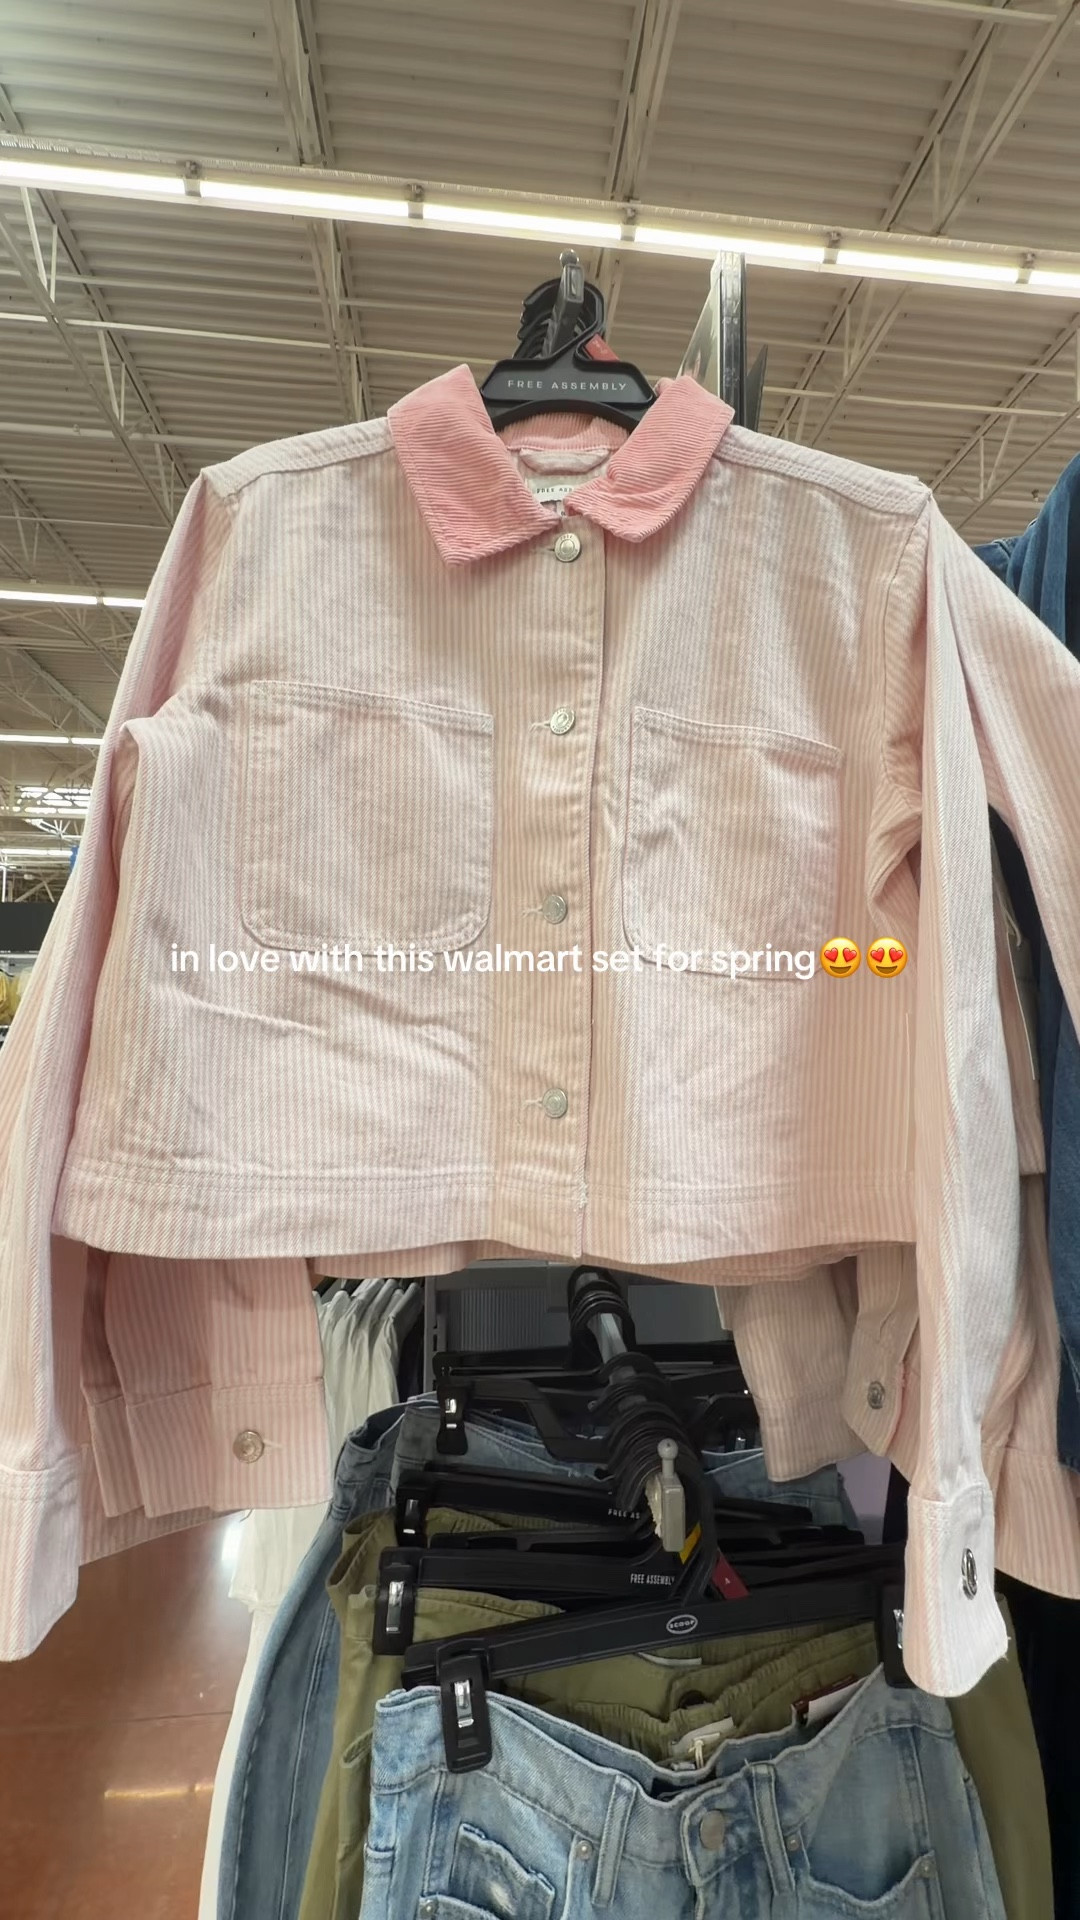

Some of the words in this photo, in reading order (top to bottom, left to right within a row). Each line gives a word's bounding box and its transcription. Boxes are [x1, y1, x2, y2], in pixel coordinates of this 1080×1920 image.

[507, 379, 543, 389] FREE
[551, 381, 627, 391] ASSEMBLY
[607, 1508, 627, 1518] FREE
[630, 1573, 645, 1584] FREE
